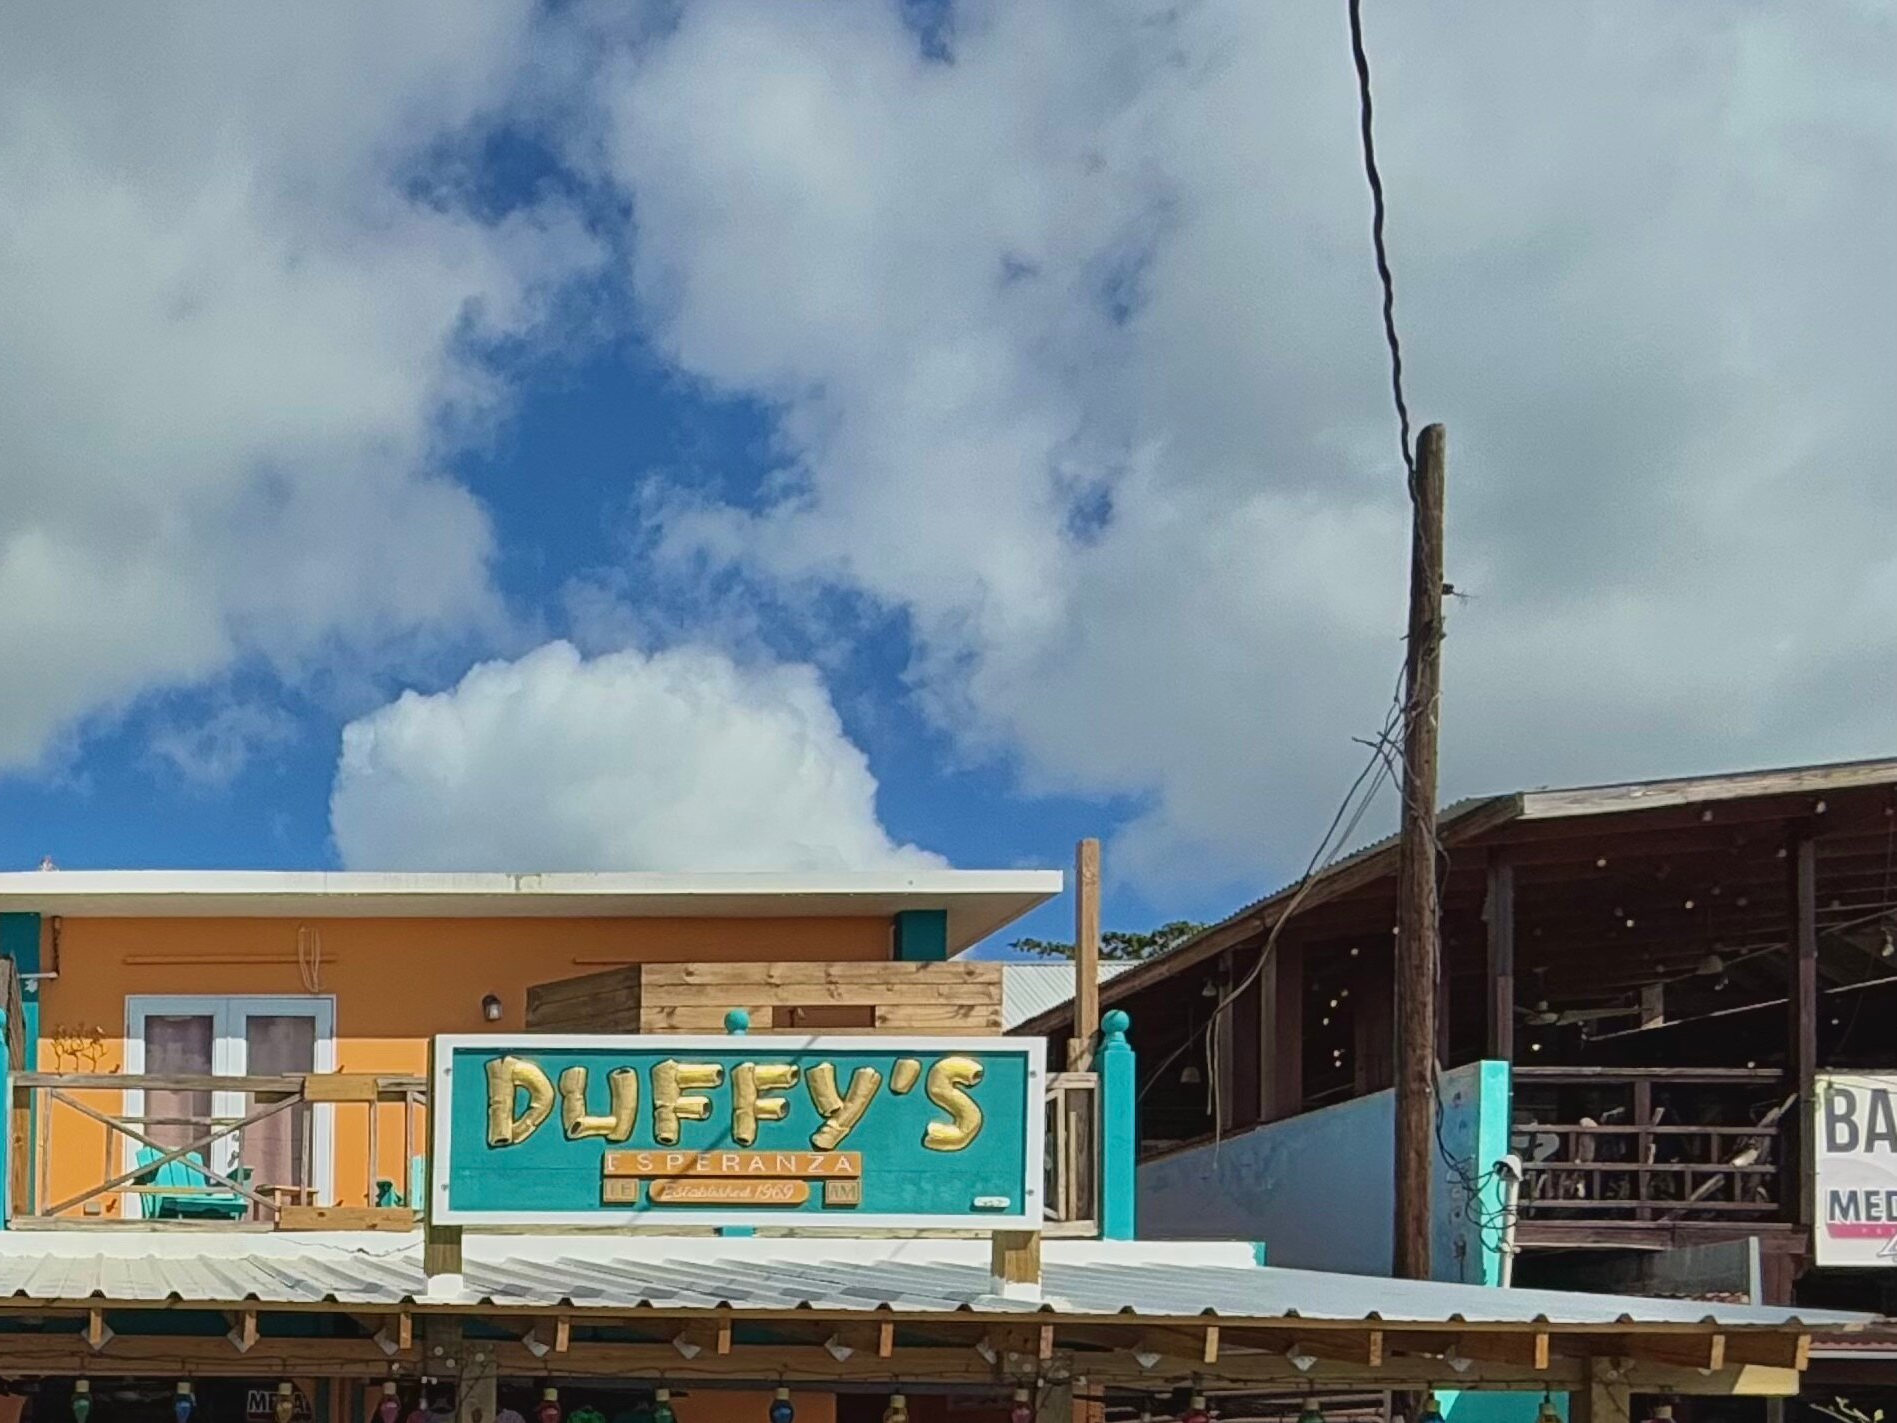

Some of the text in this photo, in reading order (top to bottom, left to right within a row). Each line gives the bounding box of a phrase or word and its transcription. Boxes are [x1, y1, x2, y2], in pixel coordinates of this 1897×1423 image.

[483, 1055, 983, 1151] DUFFY'S
[605, 1153, 853, 1173] ESPERANZA
[660, 1182, 794, 1200] Established 1969
